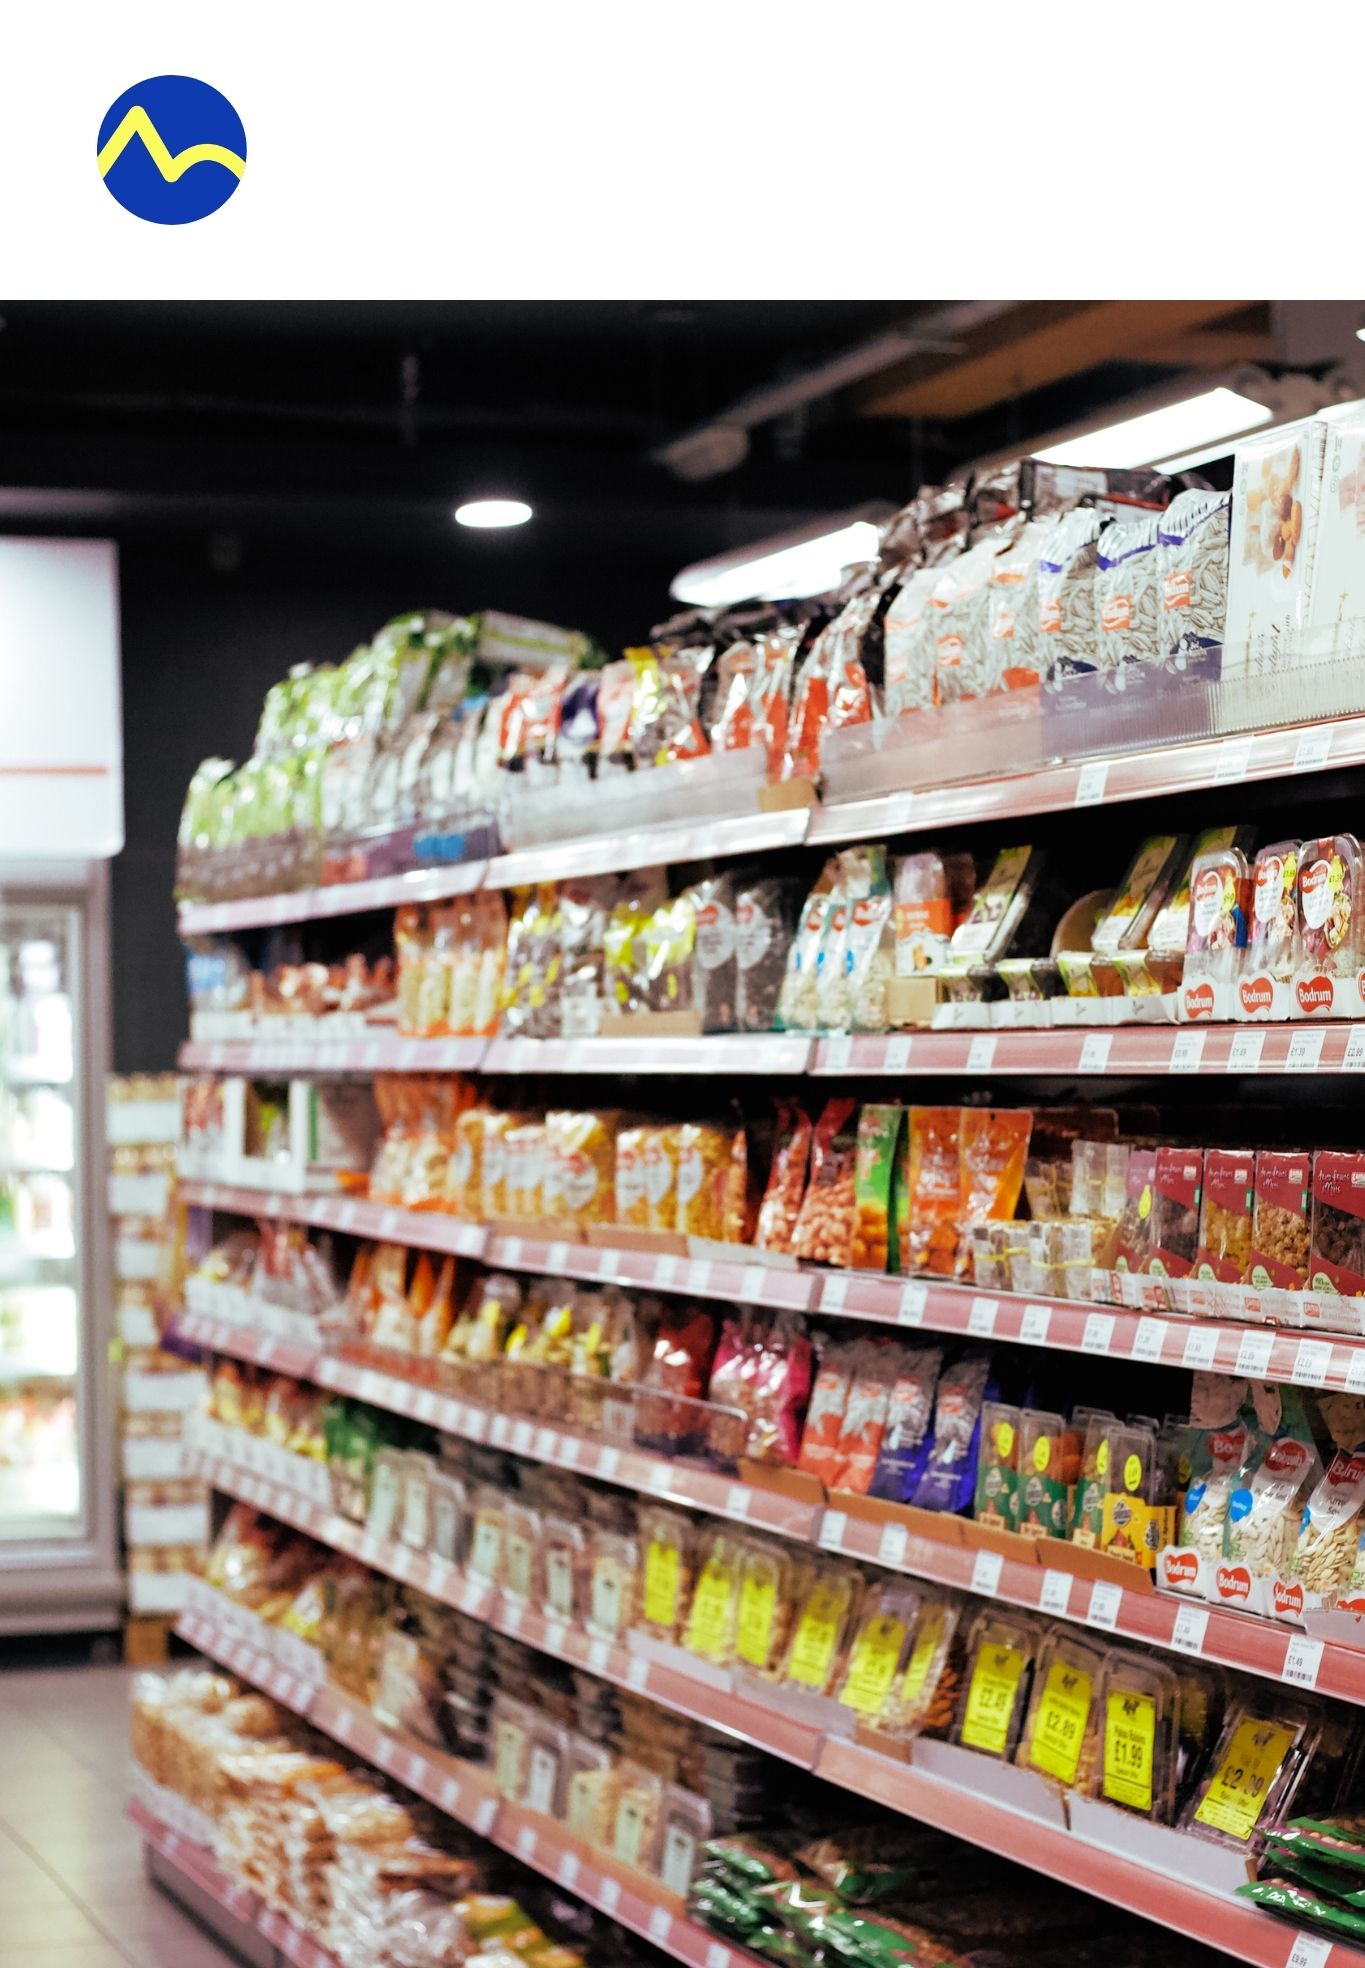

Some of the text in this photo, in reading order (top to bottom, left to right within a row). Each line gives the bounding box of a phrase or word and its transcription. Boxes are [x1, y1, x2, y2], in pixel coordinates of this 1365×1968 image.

[1186, 995, 1213, 1009] Bodrum
[1241, 989, 1271, 1004] Bodrum
[1298, 989, 1331, 1003] Bodrum
[1347, 1048, 1364, 1057] £2.99
[1166, 1558, 1197, 1577] Bodrum
[1218, 1573, 1249, 1591] Bodrum
[1288, 1655, 1303, 1667] £1.49
[1115, 1740, 1143, 1769] £1.99
